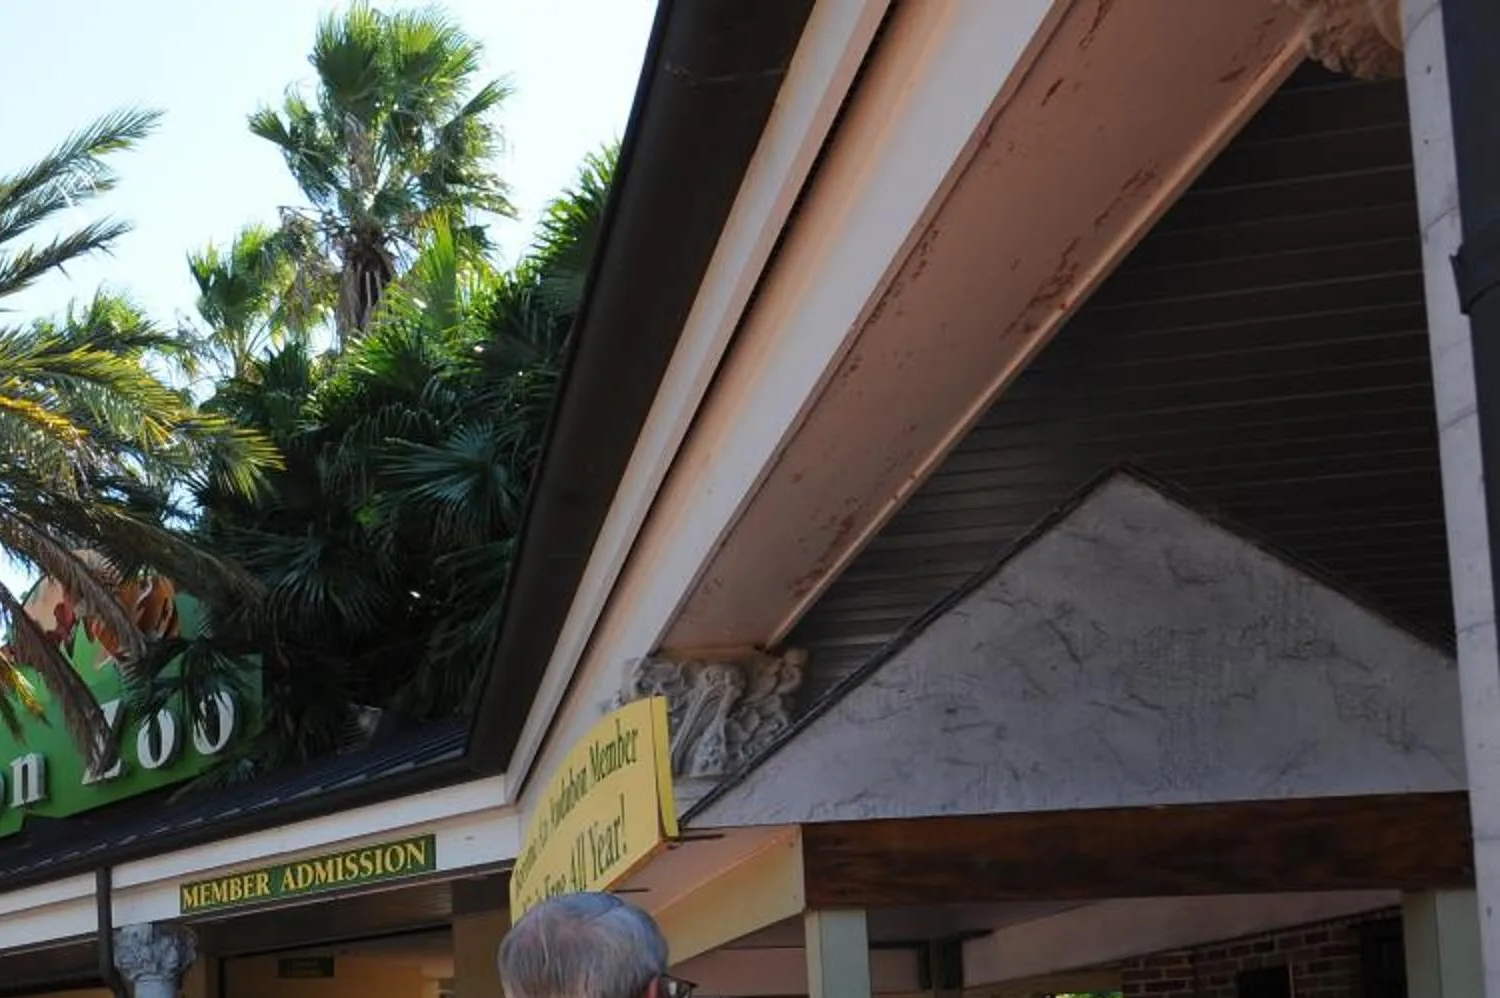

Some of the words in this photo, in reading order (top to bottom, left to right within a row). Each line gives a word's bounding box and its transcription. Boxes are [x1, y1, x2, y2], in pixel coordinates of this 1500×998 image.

[589, 718, 639, 783] Member
[588, 793, 627, 881] Year!
[182, 874, 271, 910] MEMBER
[280, 840, 427, 892] ADMISSION
